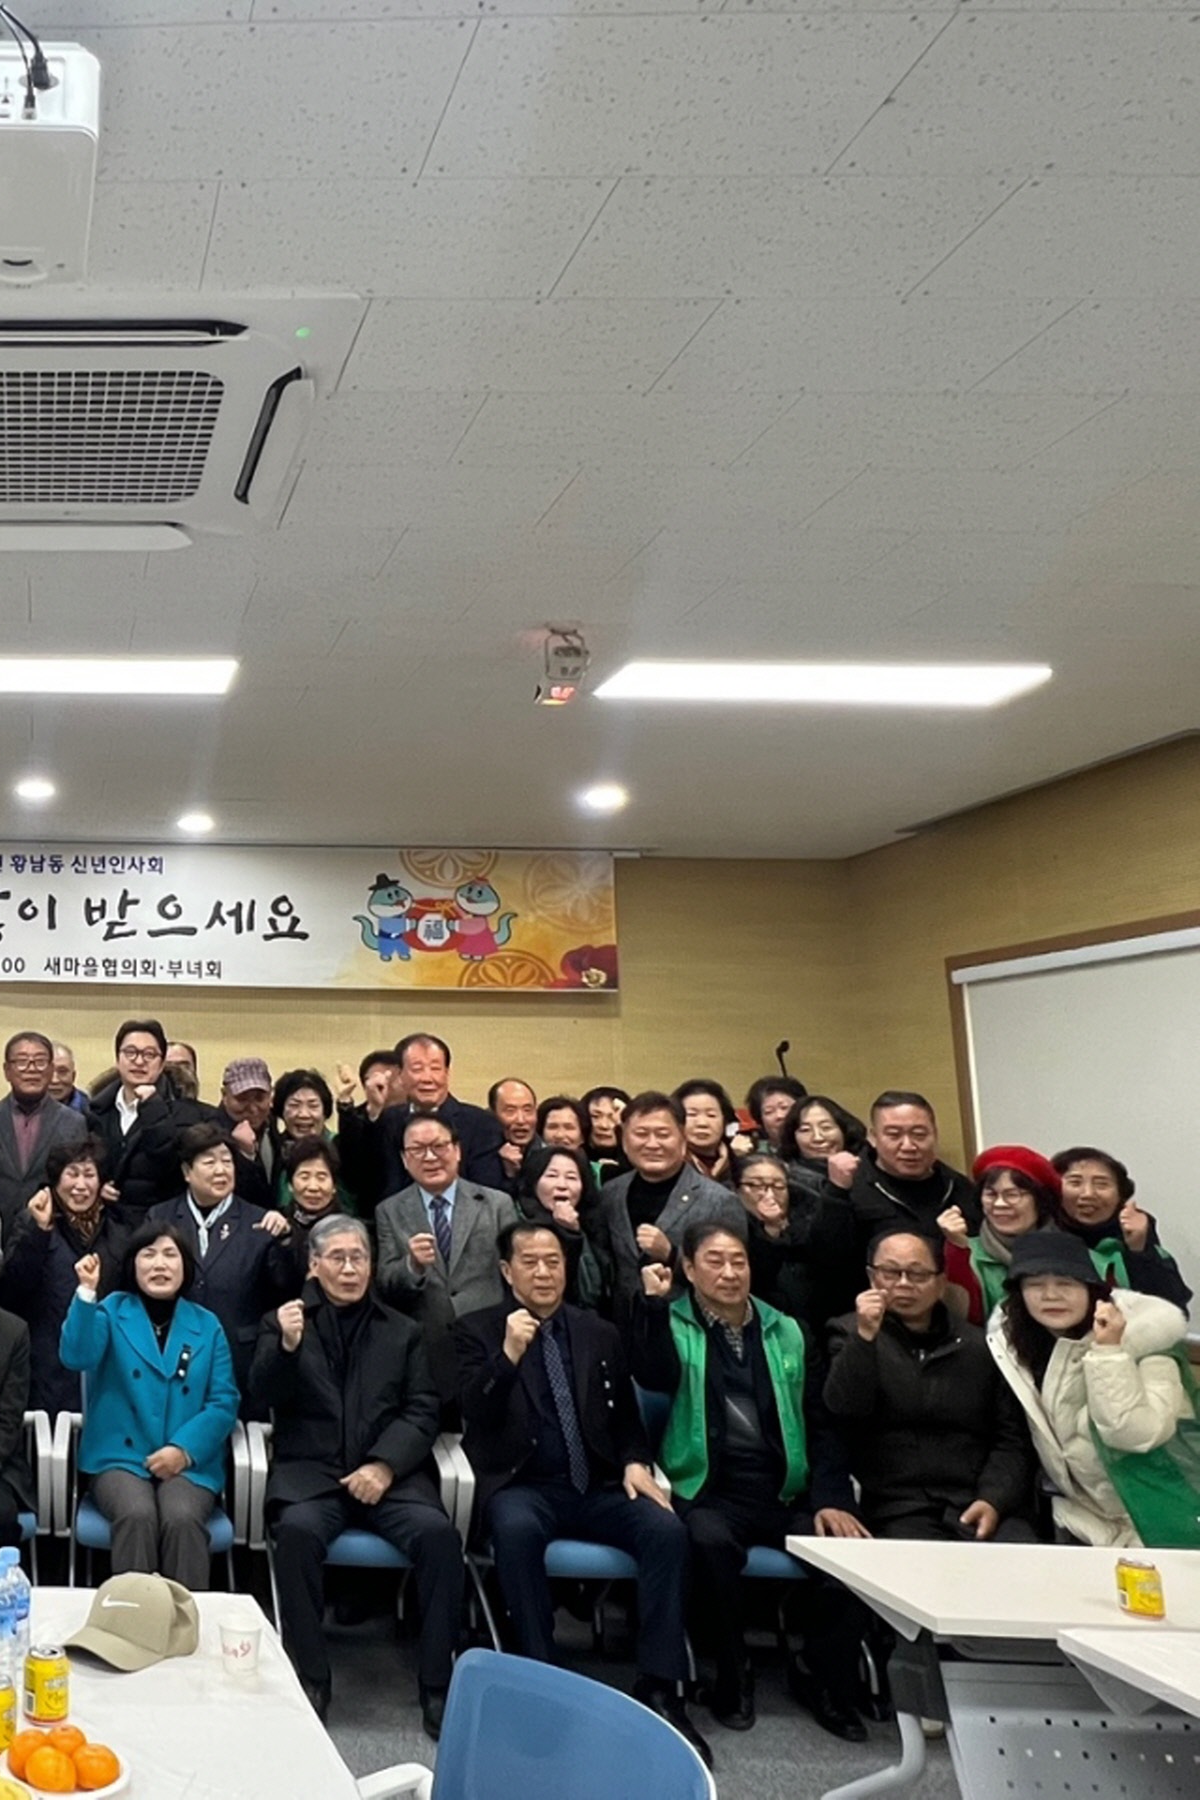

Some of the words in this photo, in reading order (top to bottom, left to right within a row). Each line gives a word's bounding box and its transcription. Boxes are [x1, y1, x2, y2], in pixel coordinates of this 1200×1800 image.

[9, 853, 65, 875] 황남동
[70, 853, 165, 875] 신년인사회
[83, 888, 310, 942] 받으세요
